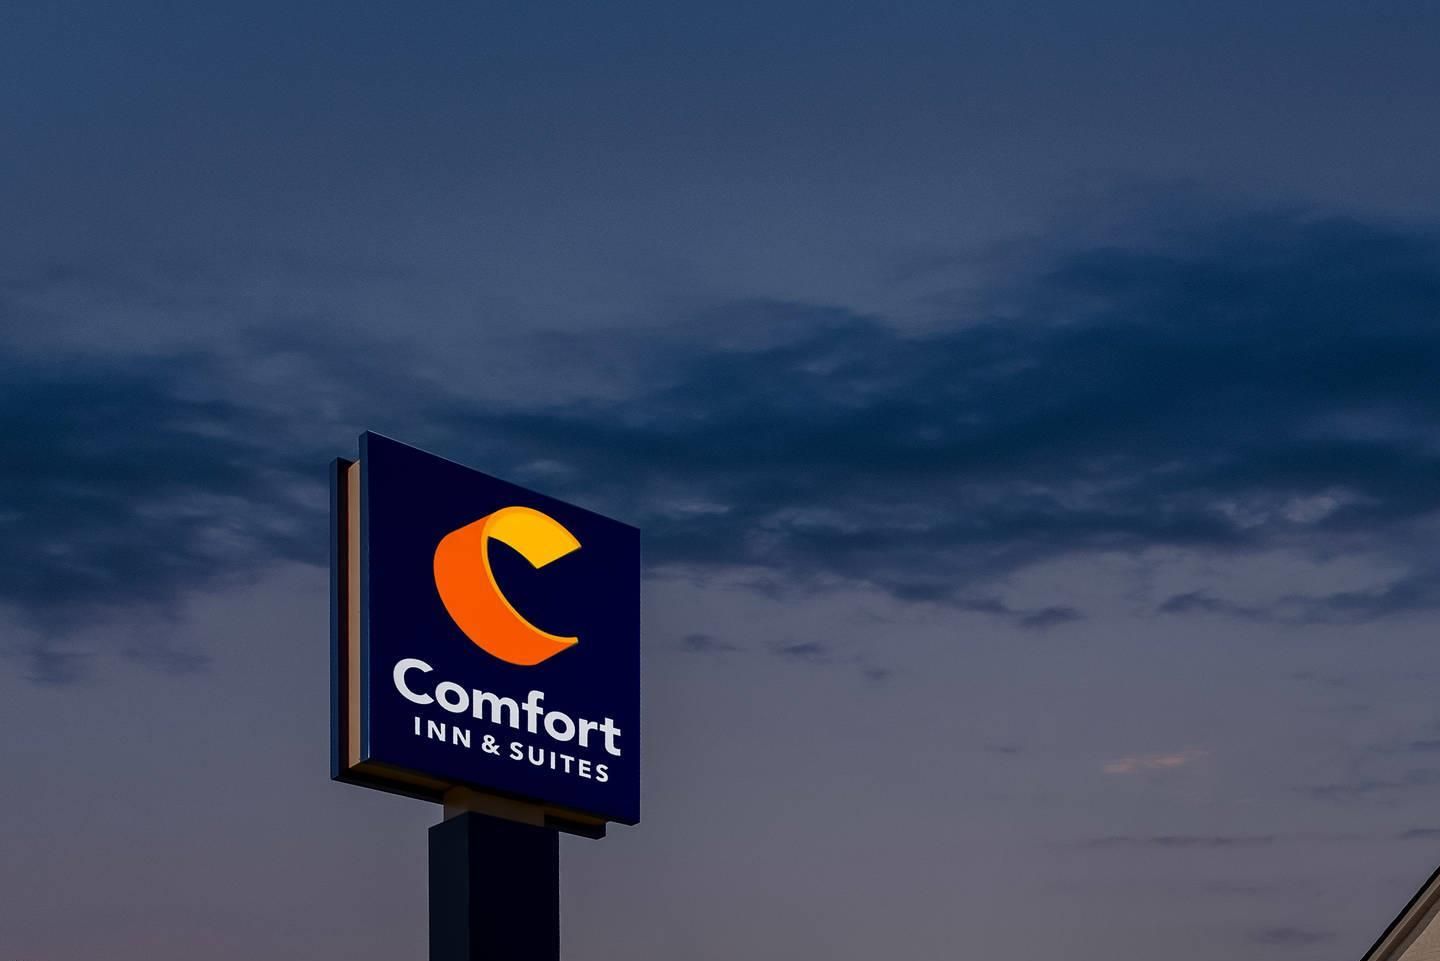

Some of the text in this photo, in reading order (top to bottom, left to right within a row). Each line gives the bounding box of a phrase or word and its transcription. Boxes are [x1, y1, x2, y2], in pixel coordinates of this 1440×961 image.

[393, 658, 622, 757] Comfort
[414, 716, 609, 783] INN & SUITES
